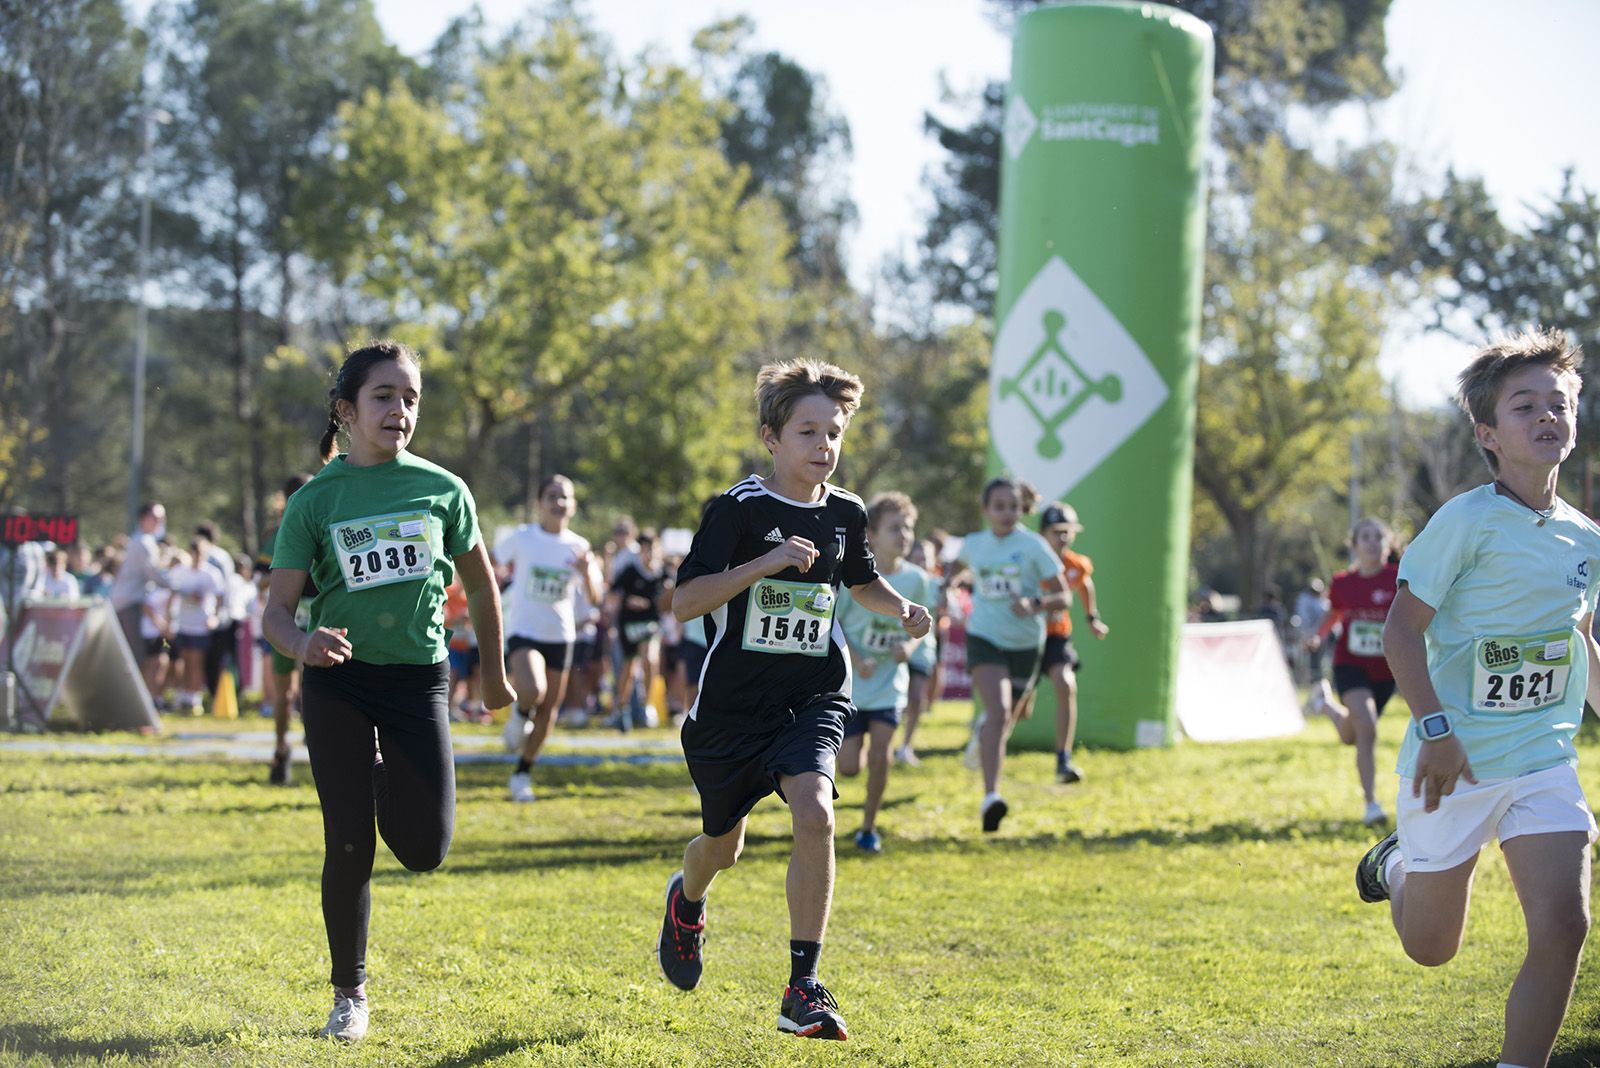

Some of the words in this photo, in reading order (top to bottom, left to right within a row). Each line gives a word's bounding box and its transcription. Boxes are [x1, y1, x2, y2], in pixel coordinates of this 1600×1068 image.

[343, 527, 372, 548] CROS
[349, 544, 418, 577] 2038
[761, 592, 790, 606] CROS
[760, 615, 820, 643] 1543
[1485, 645, 1519, 665] CROS
[1487, 669, 1554, 701] 2621
